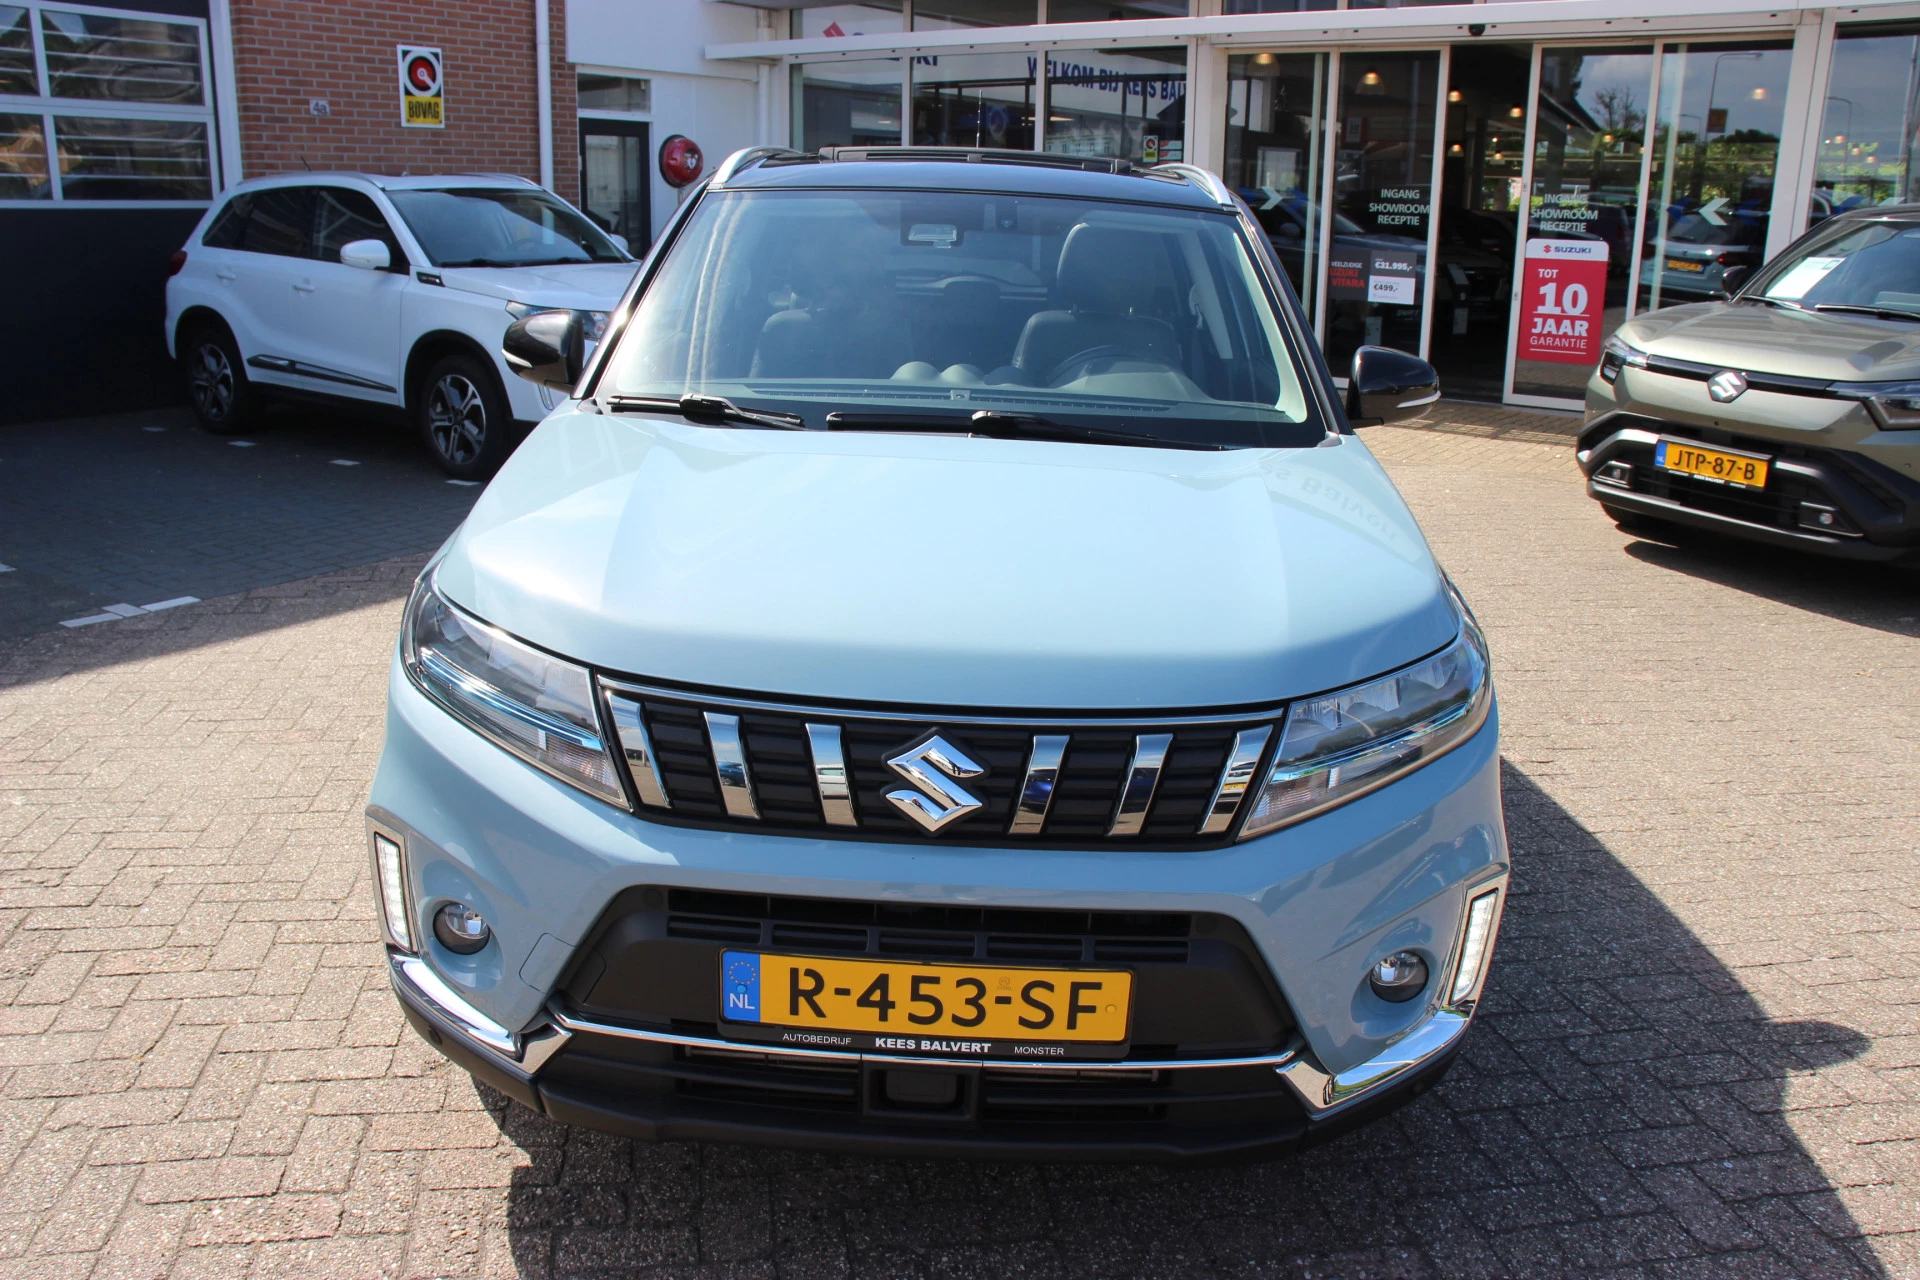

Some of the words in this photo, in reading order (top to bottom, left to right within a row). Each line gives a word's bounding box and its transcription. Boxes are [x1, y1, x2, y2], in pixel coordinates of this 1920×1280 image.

[312, 102, 328, 115] 4a
[408, 101, 440, 119] BOVAG
[1381, 189, 1420, 199] INGANG
[1544, 193, 1589, 204] INGANG
[1369, 203, 1430, 214] SHOWROOM
[1530, 208, 1599, 220] SHOWROOM
[1377, 215, 1420, 226] RECEPTIE
[1540, 221, 1587, 232] RECEPTIE
[1554, 246, 1591, 254] SUZUKI
[1329, 268, 1359, 278] UZUKI
[1538, 268, 1559, 279] TOT
[1332, 278, 1366, 289] VITARA
[1536, 282, 1589, 315] 10
[1531, 317, 1590, 337] JAAR
[1529, 335, 1588, 349] GARANTIE
[1673, 449, 1756, 480] JTP-87-B
[728, 991, 756, 1012] NL
[789, 966, 1103, 1031] R-453-SF
[782, 1031, 852, 1046] AUTOBEDRIJF
[874, 1036, 916, 1051] KEES
[920, 1039, 992, 1054] BALVERT
[1014, 1045, 1065, 1057] MONSTER
